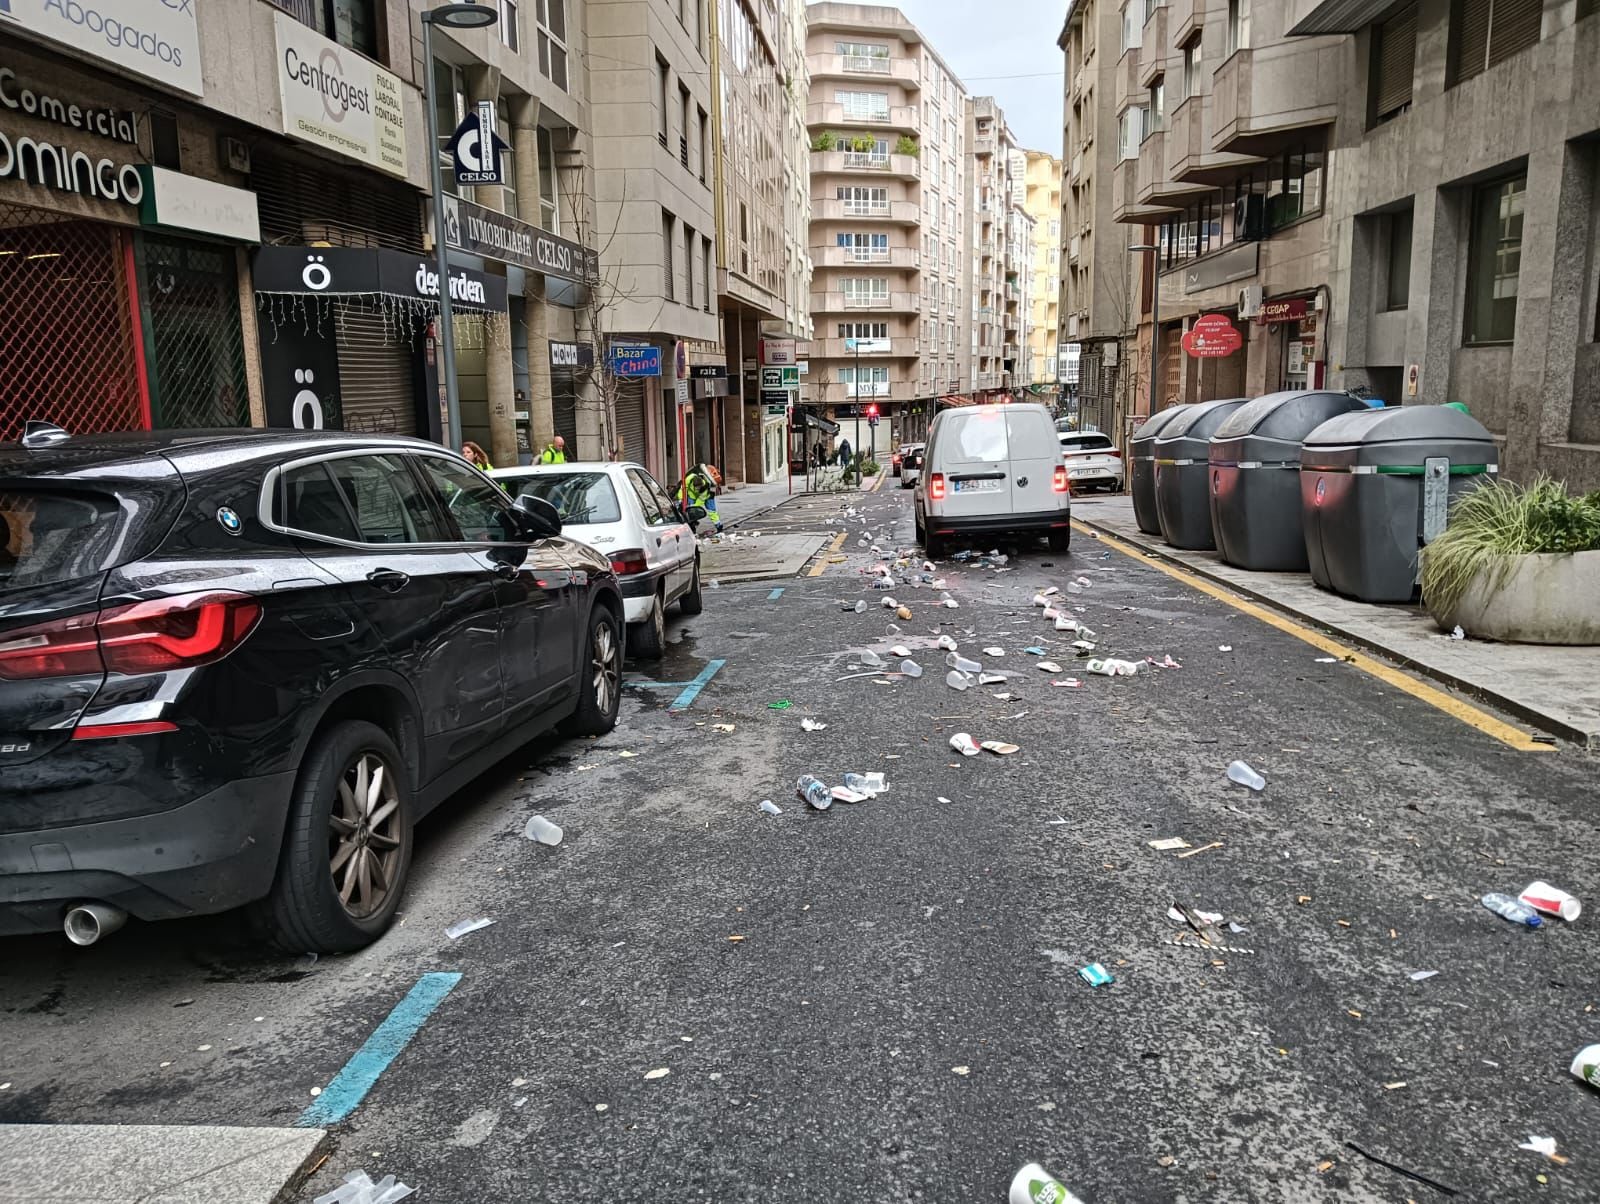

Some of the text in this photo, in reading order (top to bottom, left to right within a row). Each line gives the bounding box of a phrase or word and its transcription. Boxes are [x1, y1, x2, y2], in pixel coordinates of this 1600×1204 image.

[44, 0, 182, 67] Abogados
[285, 47, 370, 114] Centrogest
[377, 74, 396, 94] FISCAL
[0, 67, 138, 144] Comercial
[375, 89, 401, 112] LABORAL
[374, 106, 404, 129] CONTABLE
[459, 172, 497, 182] CELSO
[467, 215, 532, 257] INMOBILIARIA
[536, 236, 571, 272] CELSO
[415, 263, 486, 304] desrden
[616, 347, 645, 359] Bazar
[620, 357, 657, 374] Chino
[0, 742, 31, 753] 8d
